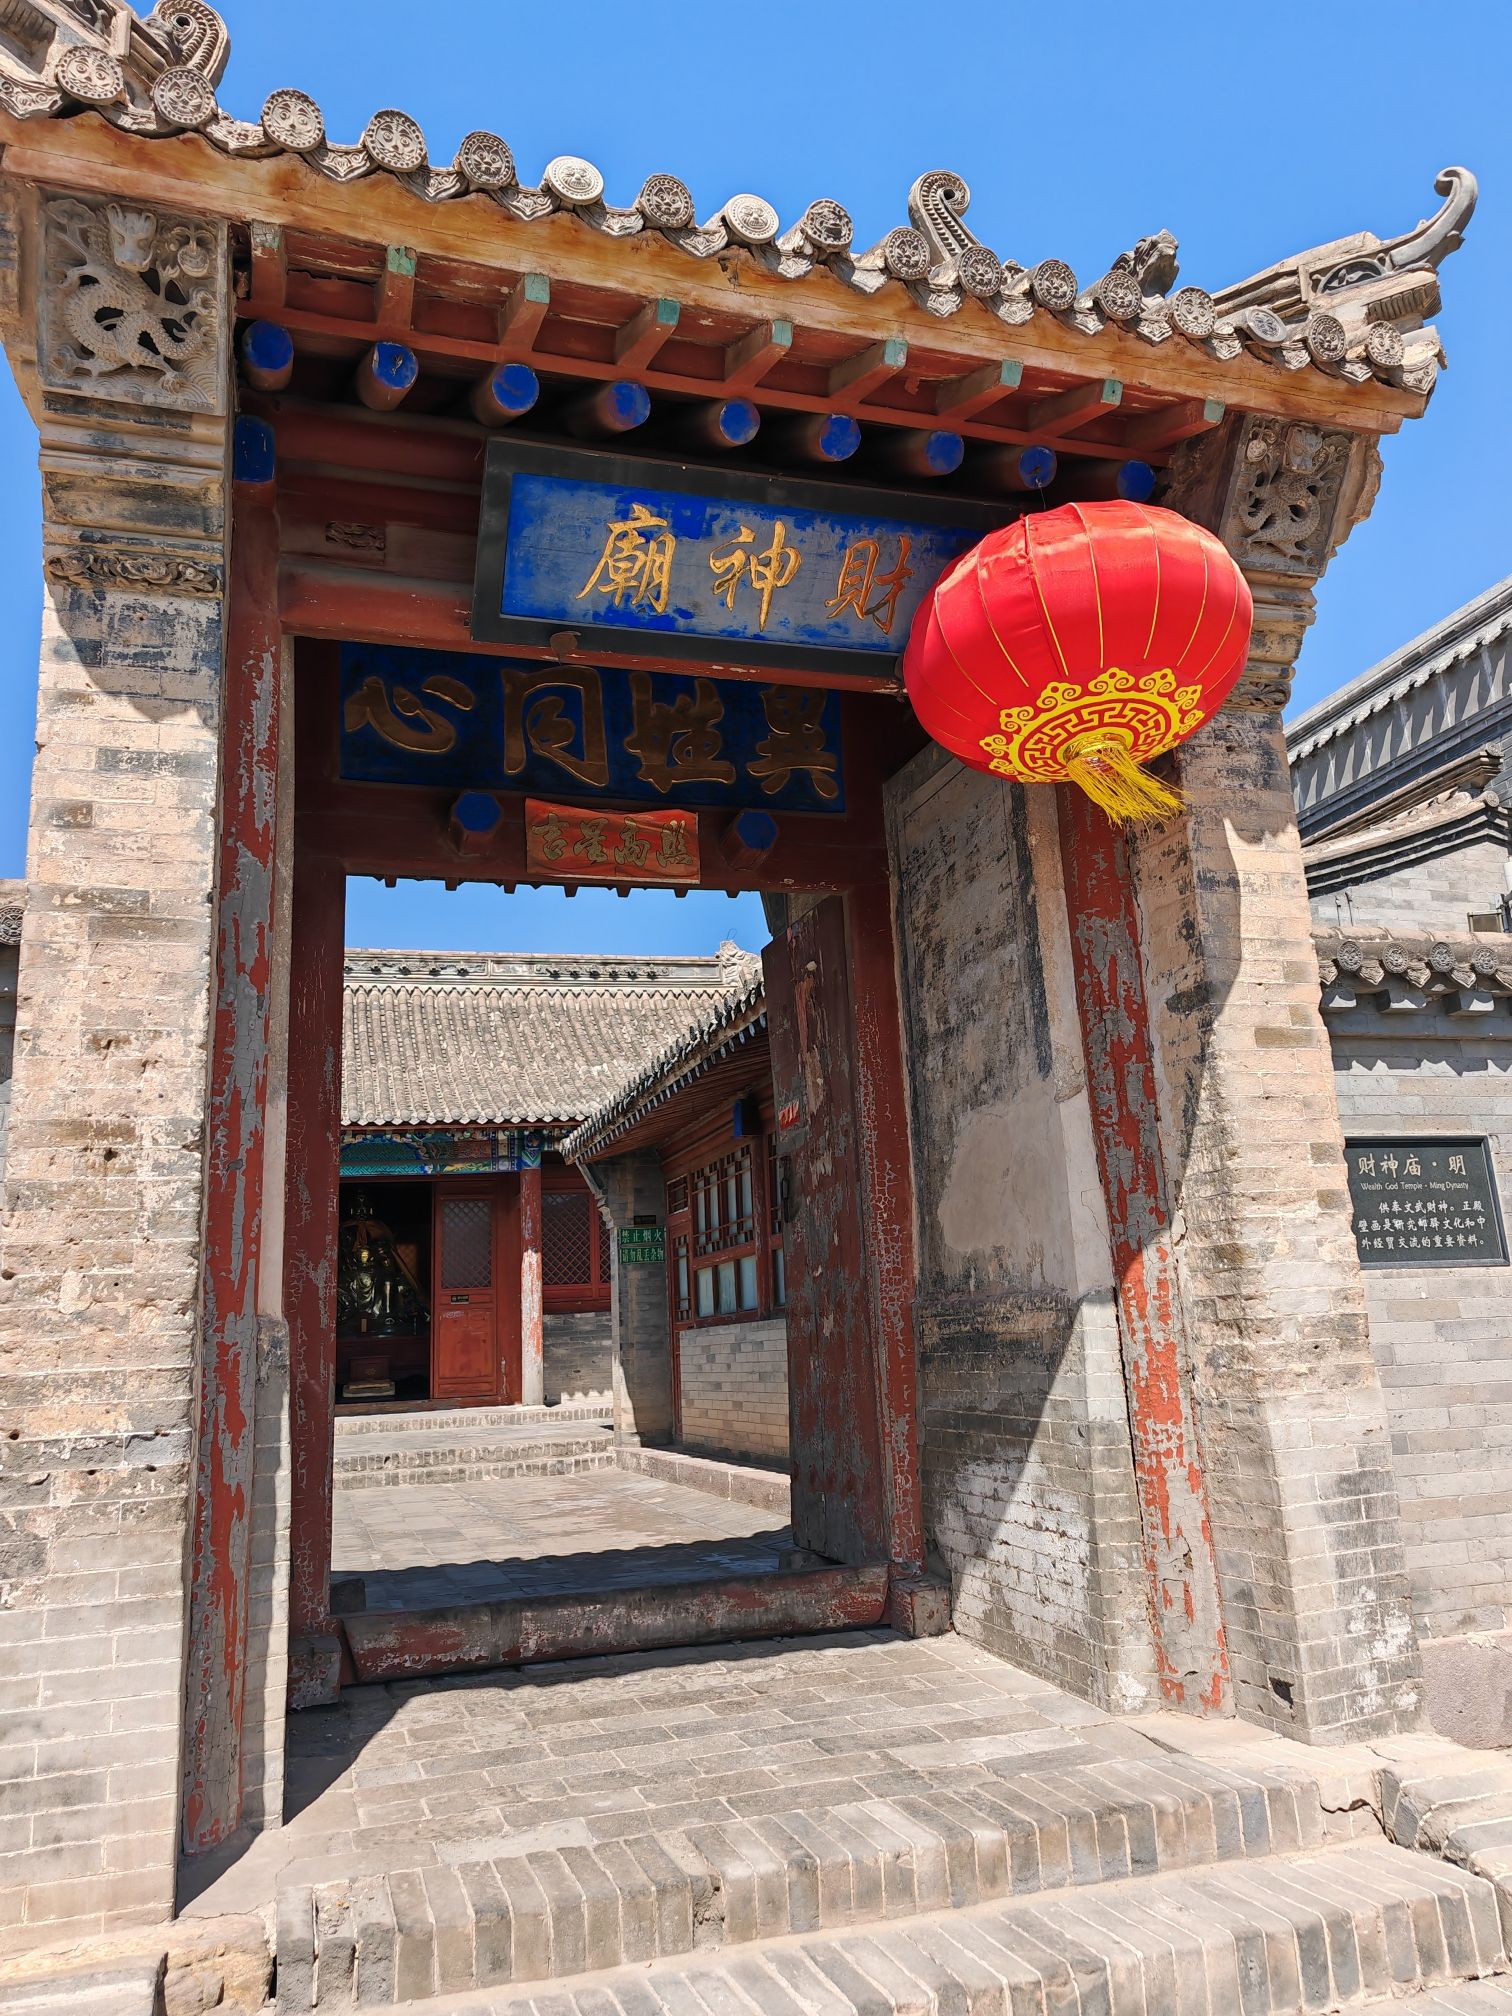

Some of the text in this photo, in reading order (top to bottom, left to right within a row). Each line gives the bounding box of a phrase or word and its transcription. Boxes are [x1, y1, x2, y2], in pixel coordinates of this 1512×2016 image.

[576, 503, 914, 635] 財神廟
[531, 813, 693, 868] 吉星高照
[1361, 1182, 1383, 1191] Wealth
[1385, 1182, 1398, 1190] God
[1400, 1182, 1423, 1191] Temple
[1429, 1182, 1445, 1191] Ming
[1446, 1182, 1469, 1190] Dynasty
[622, 1229, 662, 1243] 禁止烟火
